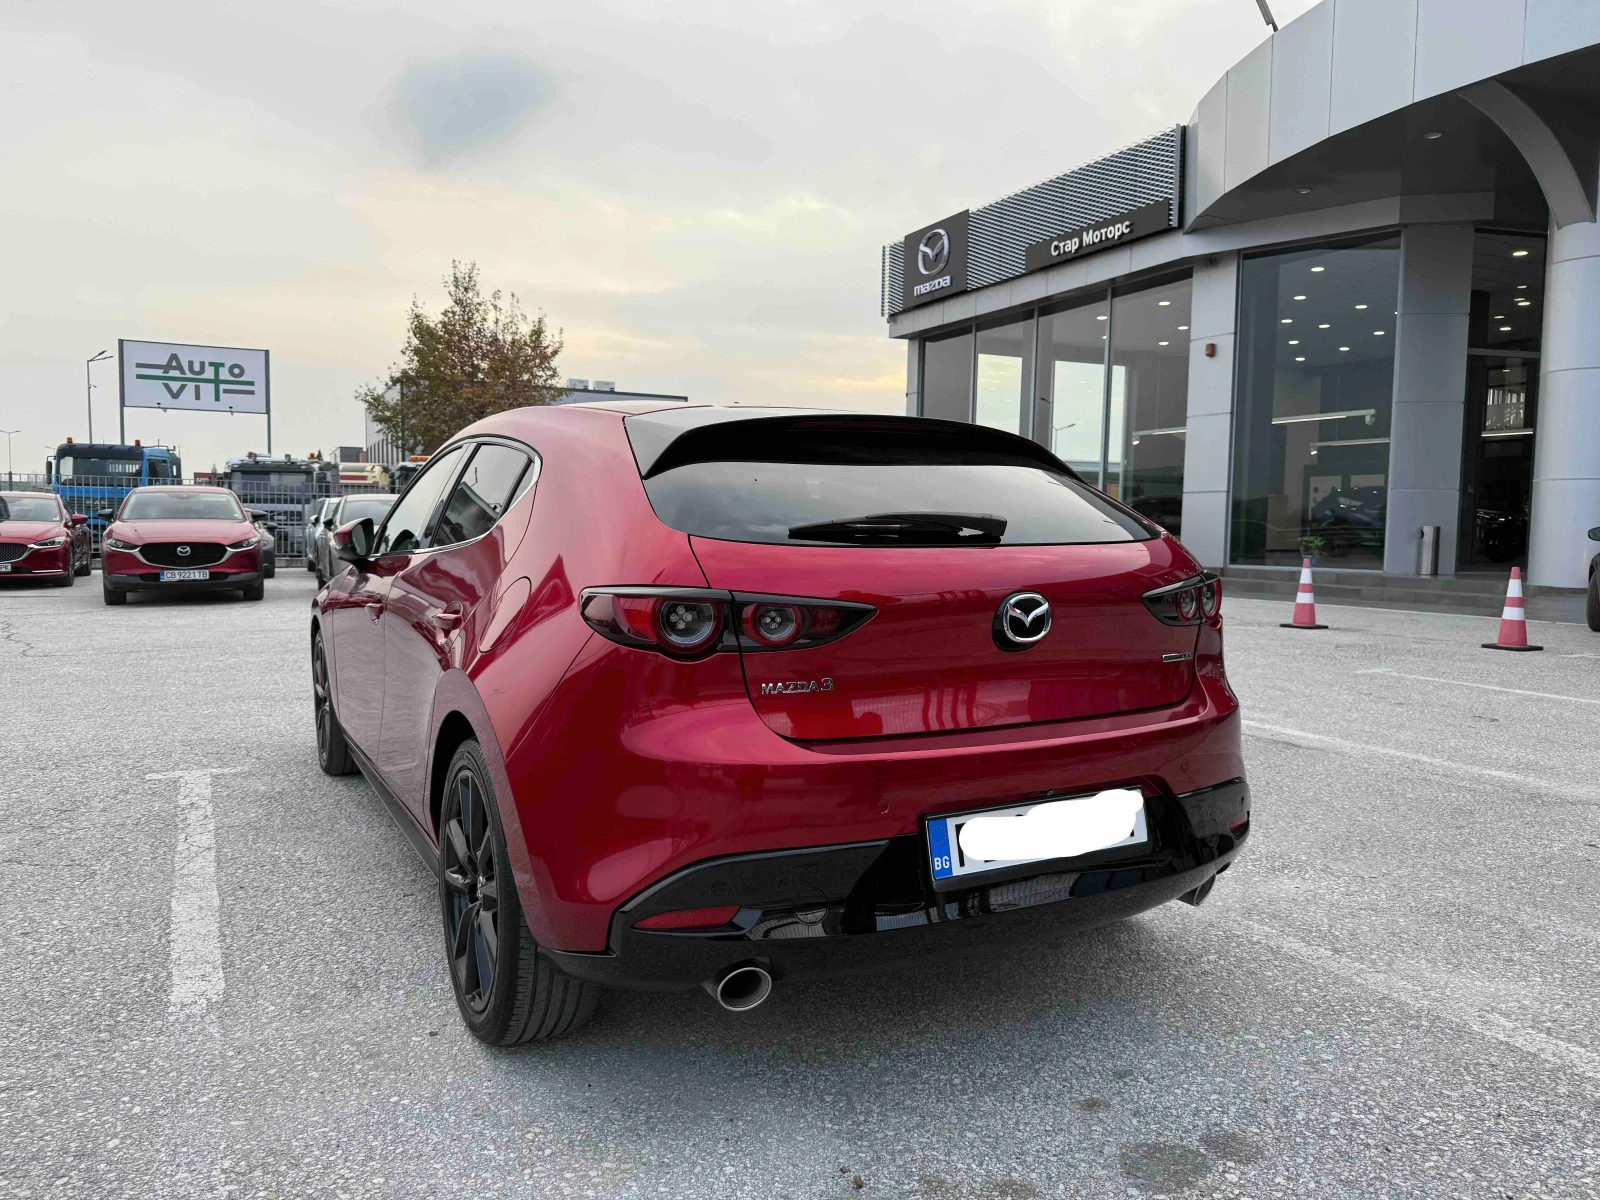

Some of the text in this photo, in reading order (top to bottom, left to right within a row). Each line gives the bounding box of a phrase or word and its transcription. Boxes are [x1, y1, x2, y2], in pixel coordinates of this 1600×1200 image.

[1051, 220, 1131, 256] Стар Моторс
[913, 275, 952, 297] mazda
[165, 570, 208, 579] CB 9221 TB
[933, 855, 950, 871] BG
